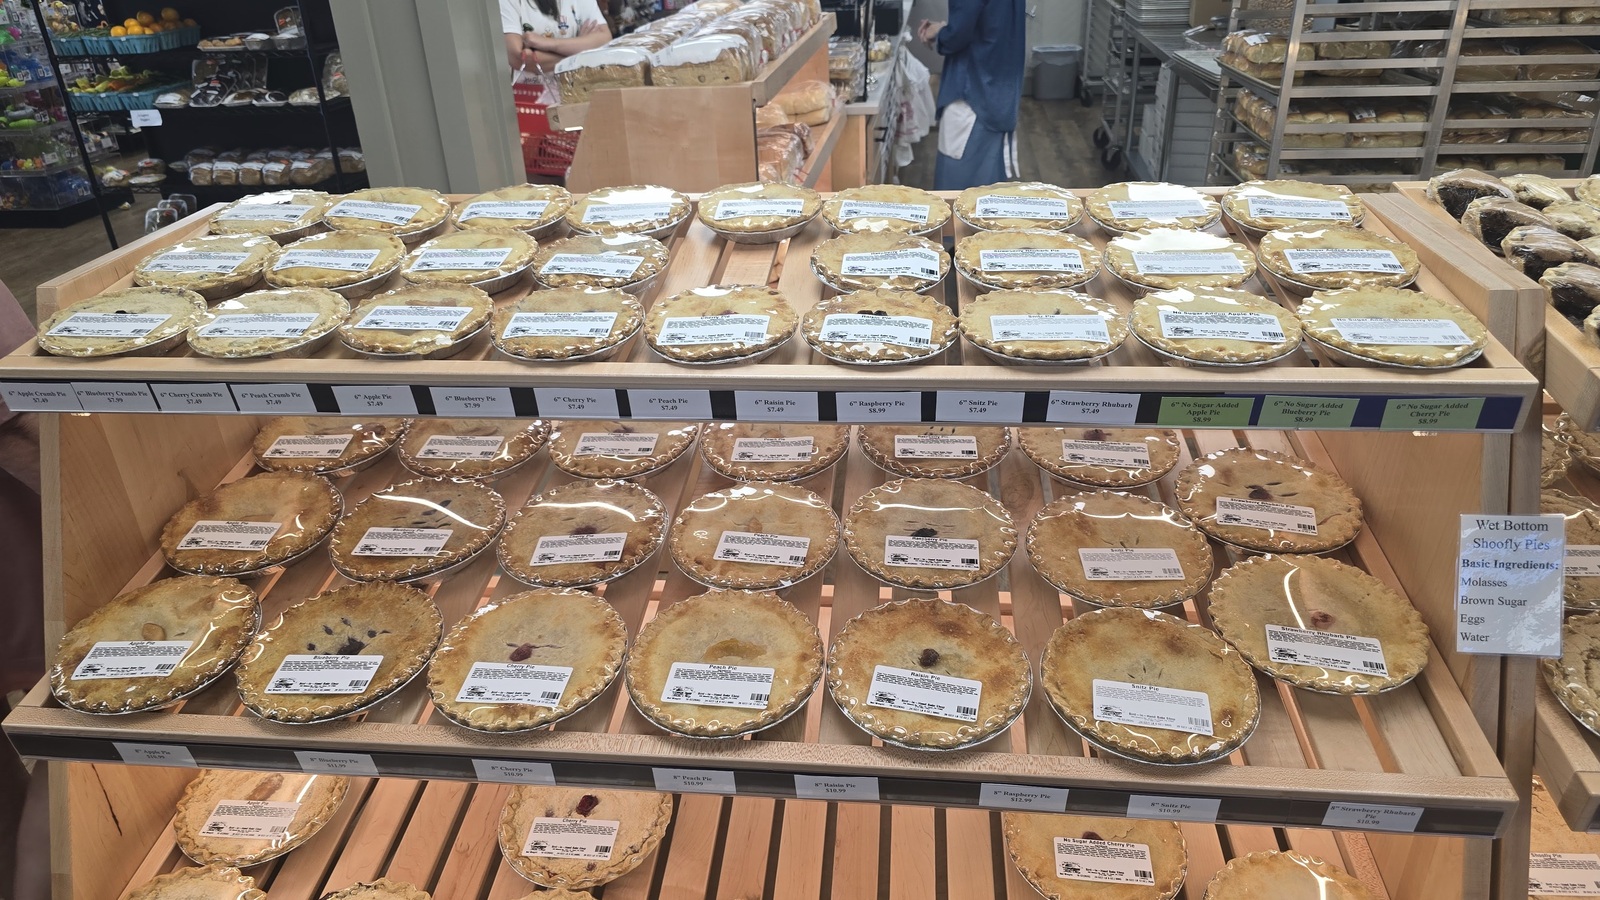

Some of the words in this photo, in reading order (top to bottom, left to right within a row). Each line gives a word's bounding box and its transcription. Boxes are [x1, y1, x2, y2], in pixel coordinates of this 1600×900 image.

[1476, 520, 1502, 530] Wet
[1503, 520, 1548, 531] Bottom
[1473, 538, 1521, 551] Shoofly
[1525, 539, 1550, 550] Pies
[1462, 559, 1490, 568] Basic
[1494, 560, 1559, 570] Ingredients:
[1461, 578, 1507, 586] Molasses
[1461, 596, 1494, 605] Brown
[1498, 597, 1527, 608] Sugar
[1460, 614, 1485, 625] Eggs
[1282, 627, 1315, 635] Strawberry
[1460, 632, 1489, 641] Water
[1003, 791, 1038, 799] Raspberry
[1341, 806, 1381, 815] Strawberry
[1384, 809, 1416, 817] Rhubarb
